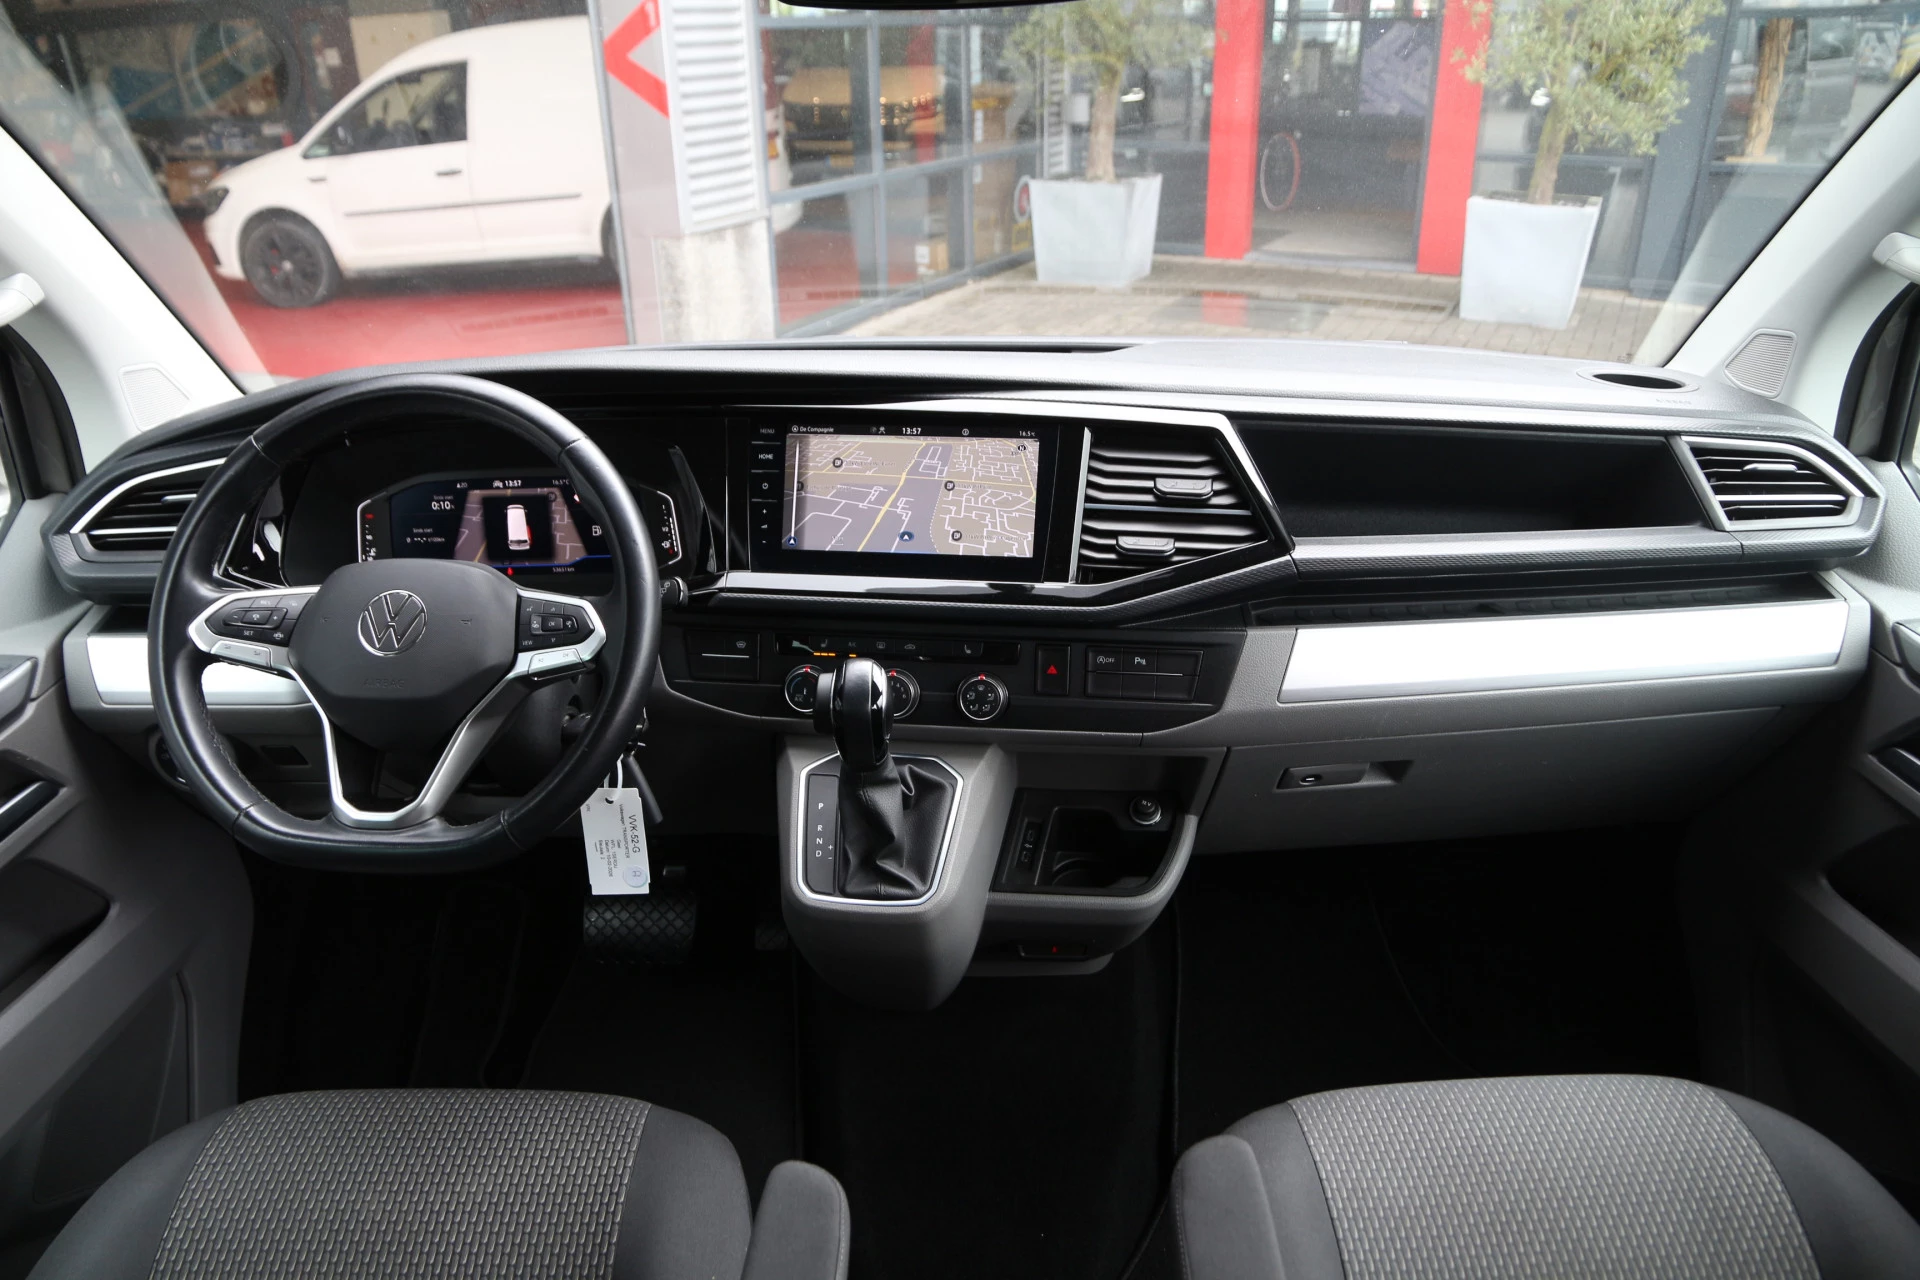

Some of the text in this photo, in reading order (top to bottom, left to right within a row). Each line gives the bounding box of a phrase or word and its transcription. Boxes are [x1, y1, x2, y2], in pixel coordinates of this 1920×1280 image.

[902, 427, 921, 435] 13:57
[504, 479, 521, 487] 13:57
[431, 501, 451, 510] 0:10
[818, 802, 824, 810] P
[817, 824, 823, 832] R
[816, 837, 823, 845] N
